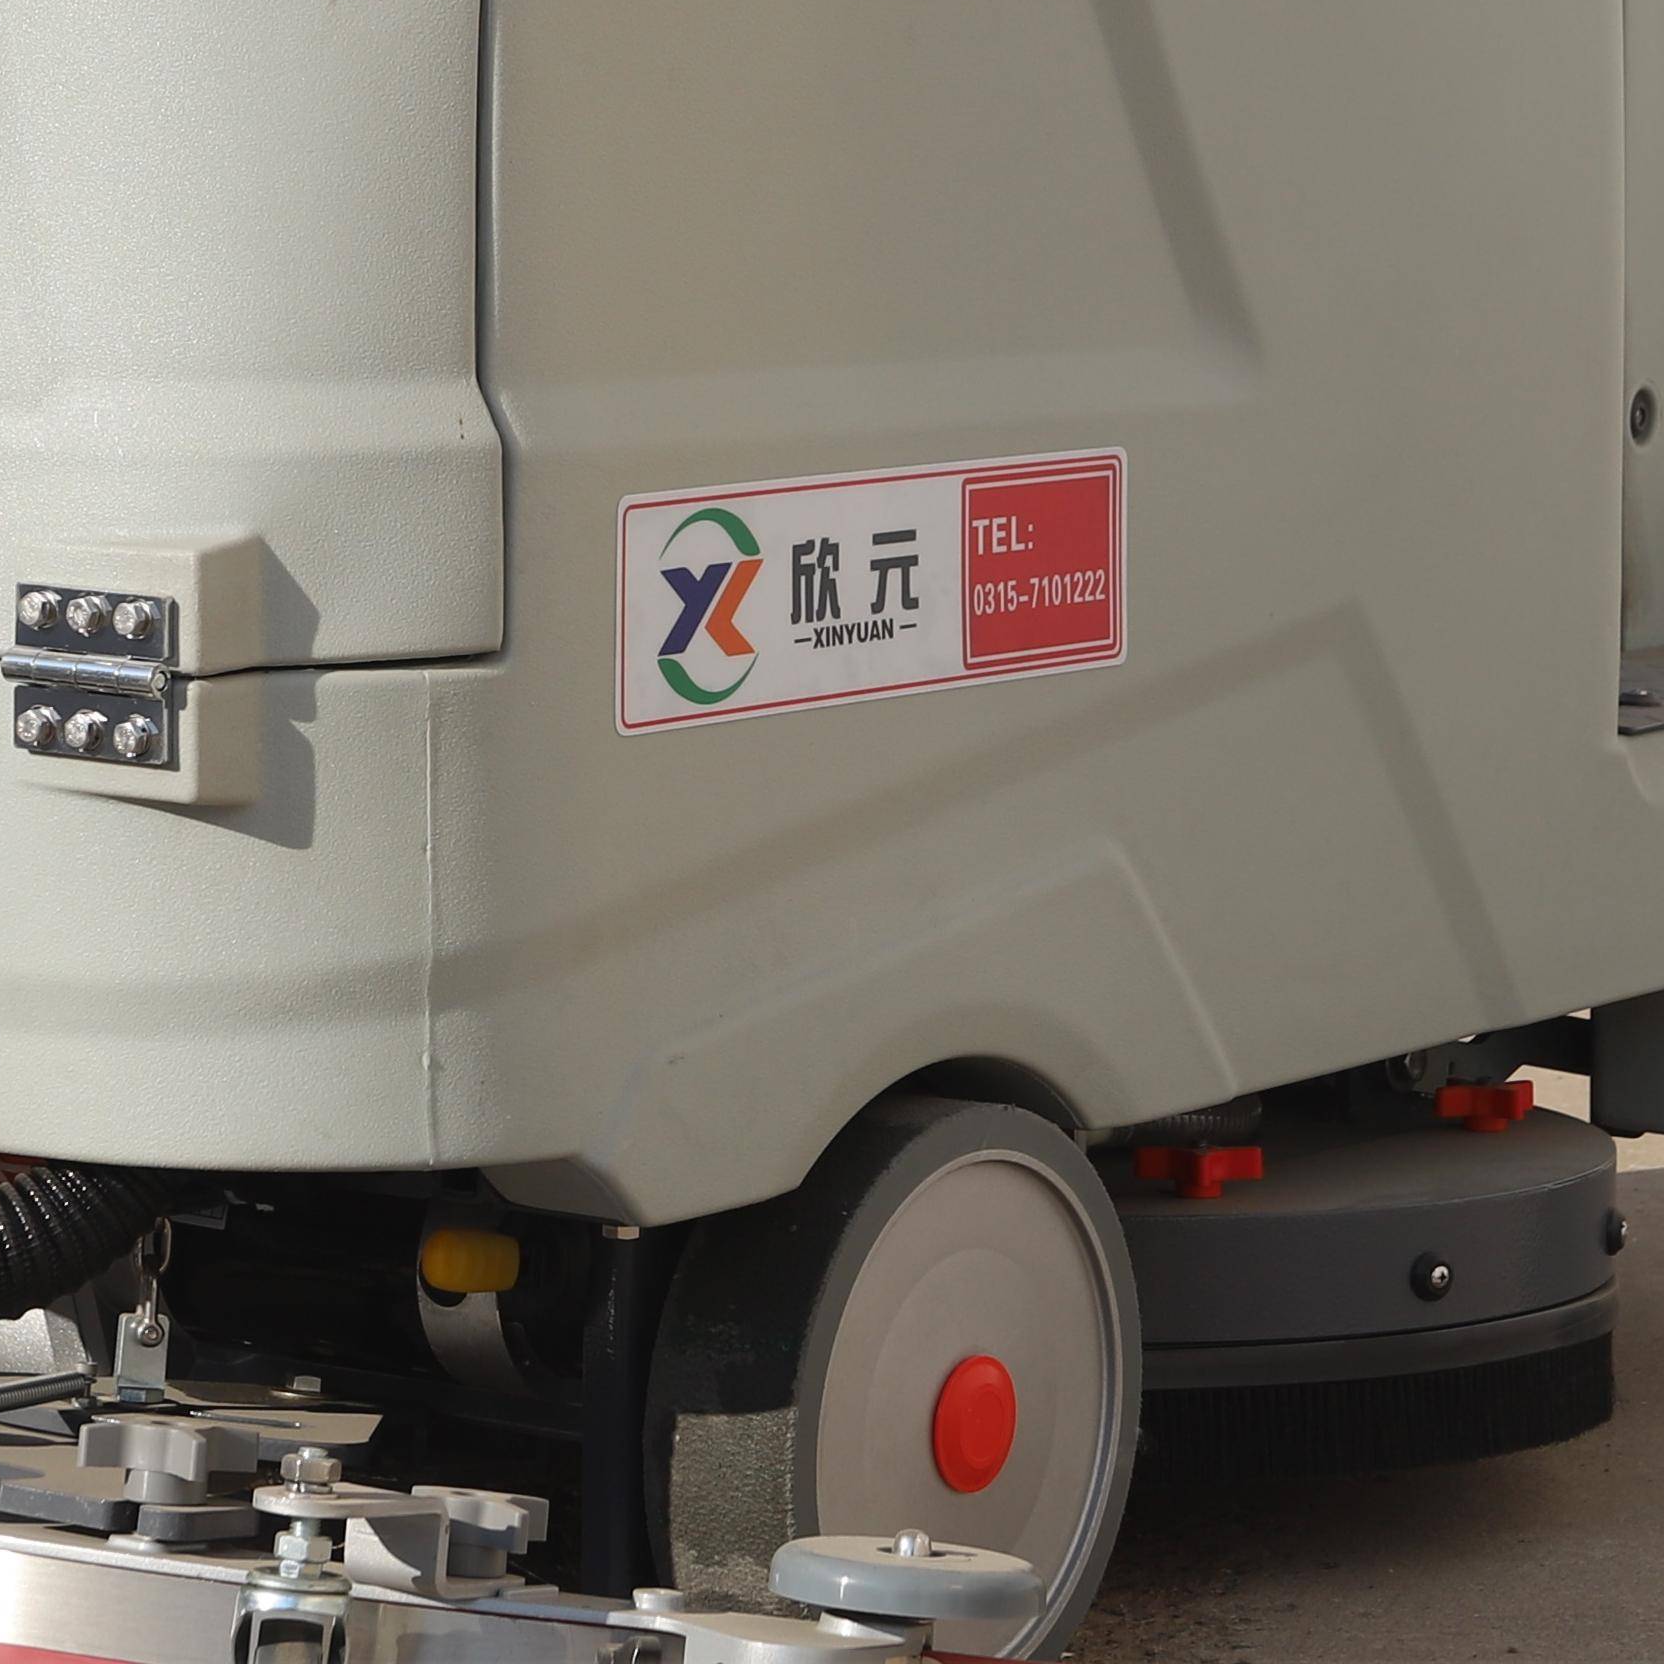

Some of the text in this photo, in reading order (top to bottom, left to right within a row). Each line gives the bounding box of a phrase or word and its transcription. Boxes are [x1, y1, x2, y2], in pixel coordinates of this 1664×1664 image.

[971, 515, 1034, 556] TEL:
[790, 528, 920, 626] 欣元
[973, 569, 1107, 616] 0315-7101222
[812, 617, 895, 650] XINYUAN
